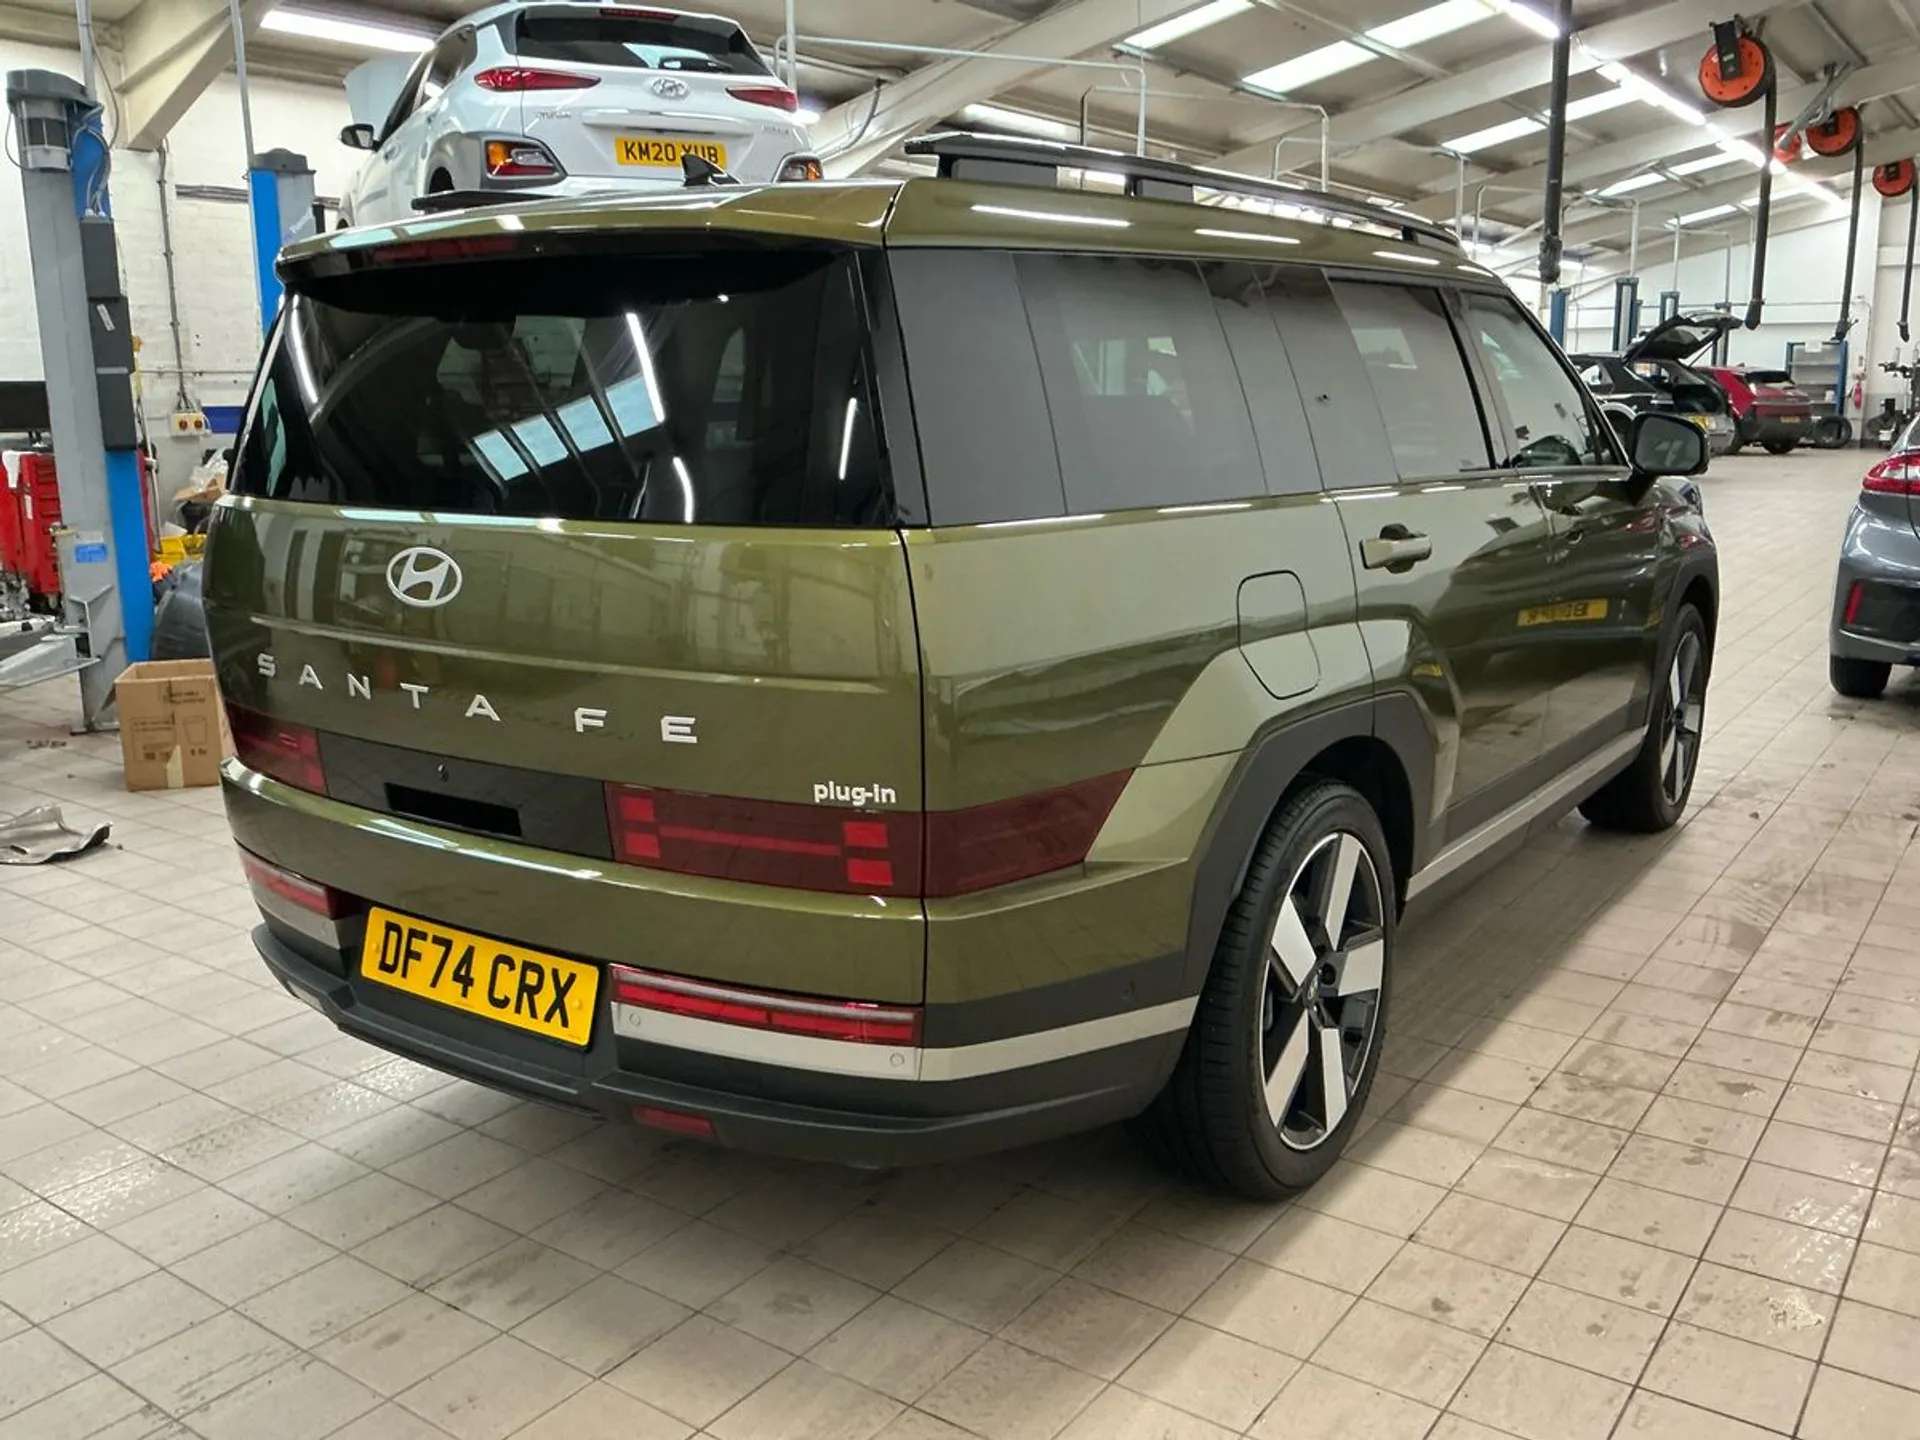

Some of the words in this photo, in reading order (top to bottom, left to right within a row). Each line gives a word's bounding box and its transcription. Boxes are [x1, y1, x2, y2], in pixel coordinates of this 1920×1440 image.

[623, 140, 676, 162] KM20
[257, 652, 501, 721] SANTA
[574, 706, 698, 743] FE
[813, 780, 897, 806] plug-in
[378, 919, 476, 999] DF74
[487, 953, 578, 1029] CRX
